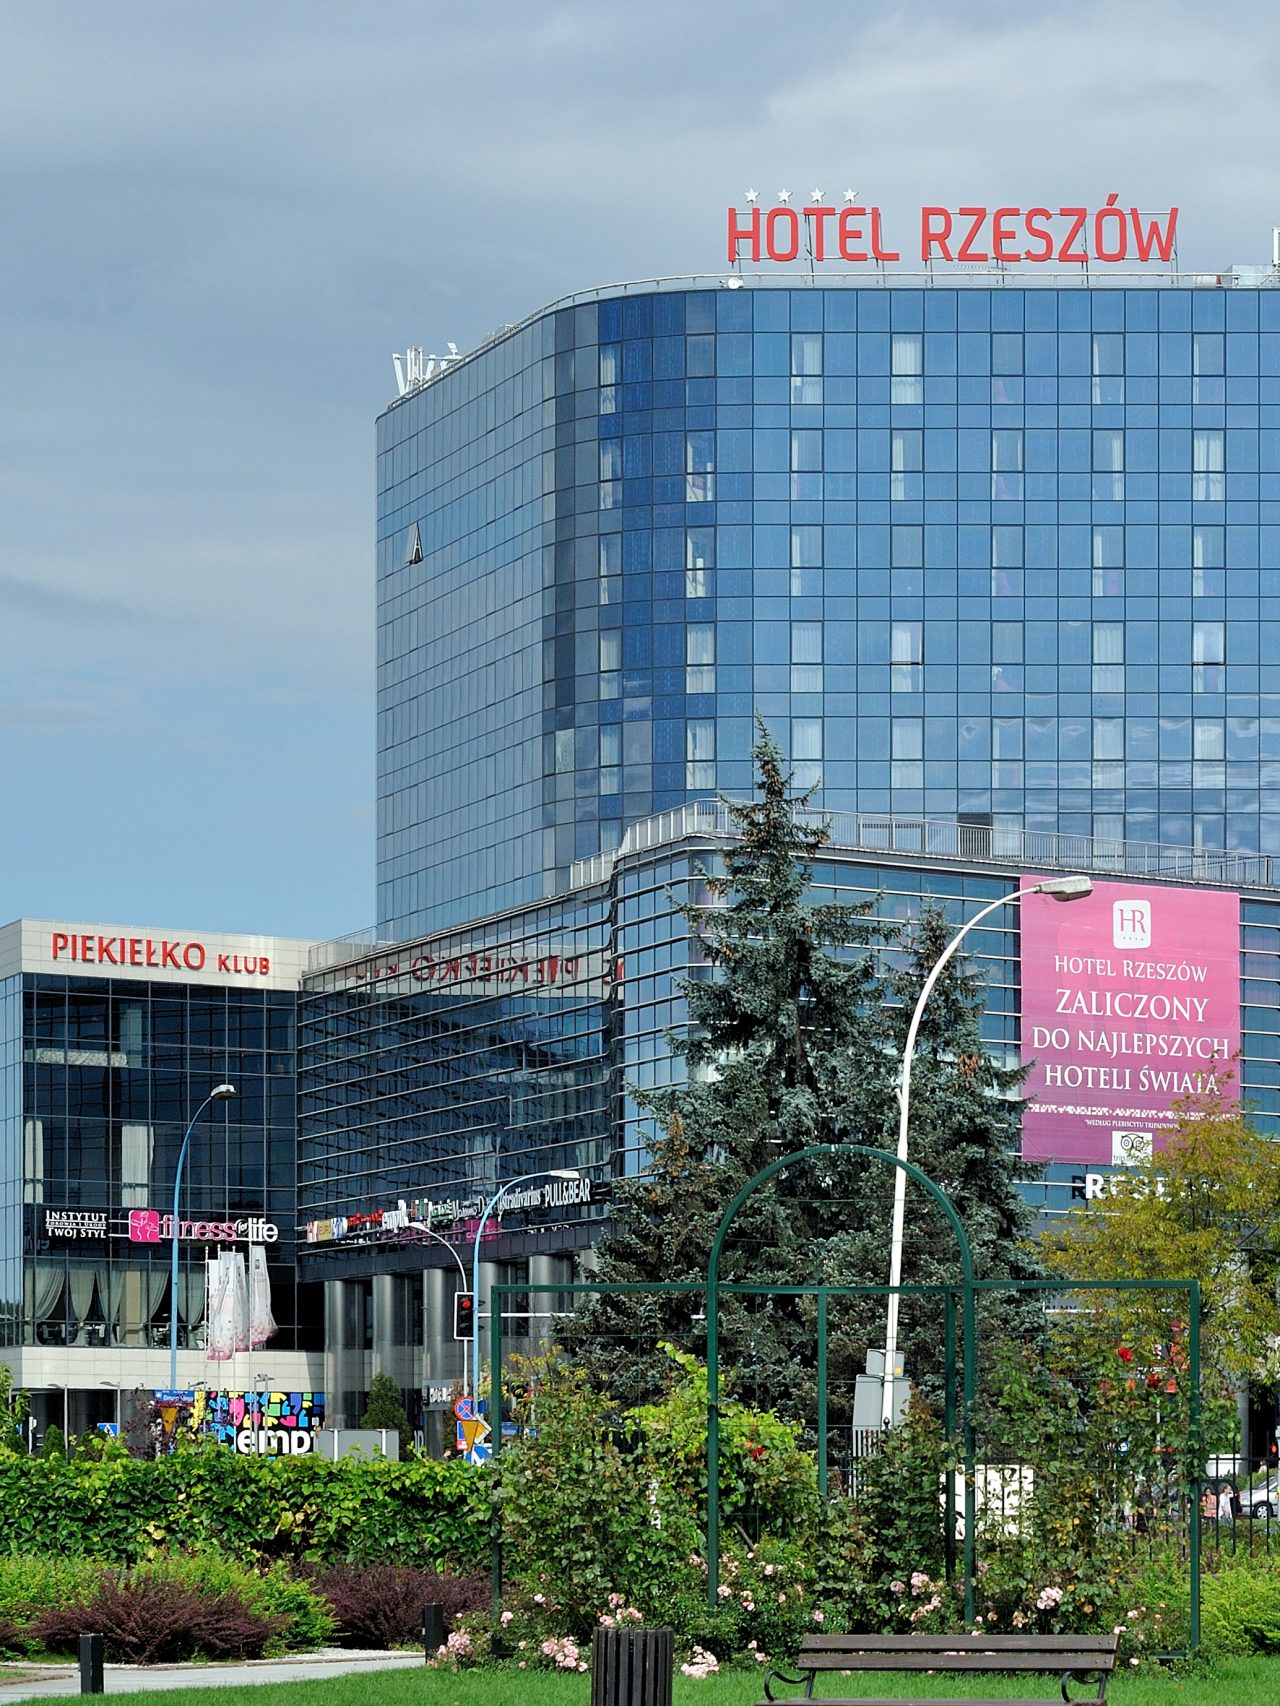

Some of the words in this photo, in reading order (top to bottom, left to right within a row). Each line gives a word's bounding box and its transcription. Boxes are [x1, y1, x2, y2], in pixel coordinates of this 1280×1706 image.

[728, 207, 900, 262] HOTEL
[921, 193, 1180, 262] RZESZÓW
[1118, 908, 1146, 934] HR
[52, 932, 206, 970] PIEKIEŁKO
[218, 953, 271, 975] KLUB
[1054, 955, 1116, 977] HOTEL
[1123, 959, 1208, 983] RZESZÓW
[1055, 988, 1209, 1022] ZALICZONY
[1032, 1026, 1070, 1050] DO
[1077, 1029, 1230, 1060] NAJLEPSZYCH
[1044, 1064, 1131, 1090] HOTELI
[1139, 1064, 1220, 1095] ŚWIATA
[544, 1178, 591, 1208] PULL&BEAR
[45, 1210, 107, 1222] INSTYTUT
[163, 1214, 237, 1241] finess
[248, 1217, 278, 1242] life
[48, 1227, 77, 1239] TWÓJ
[80, 1229, 106, 1238] STYL
